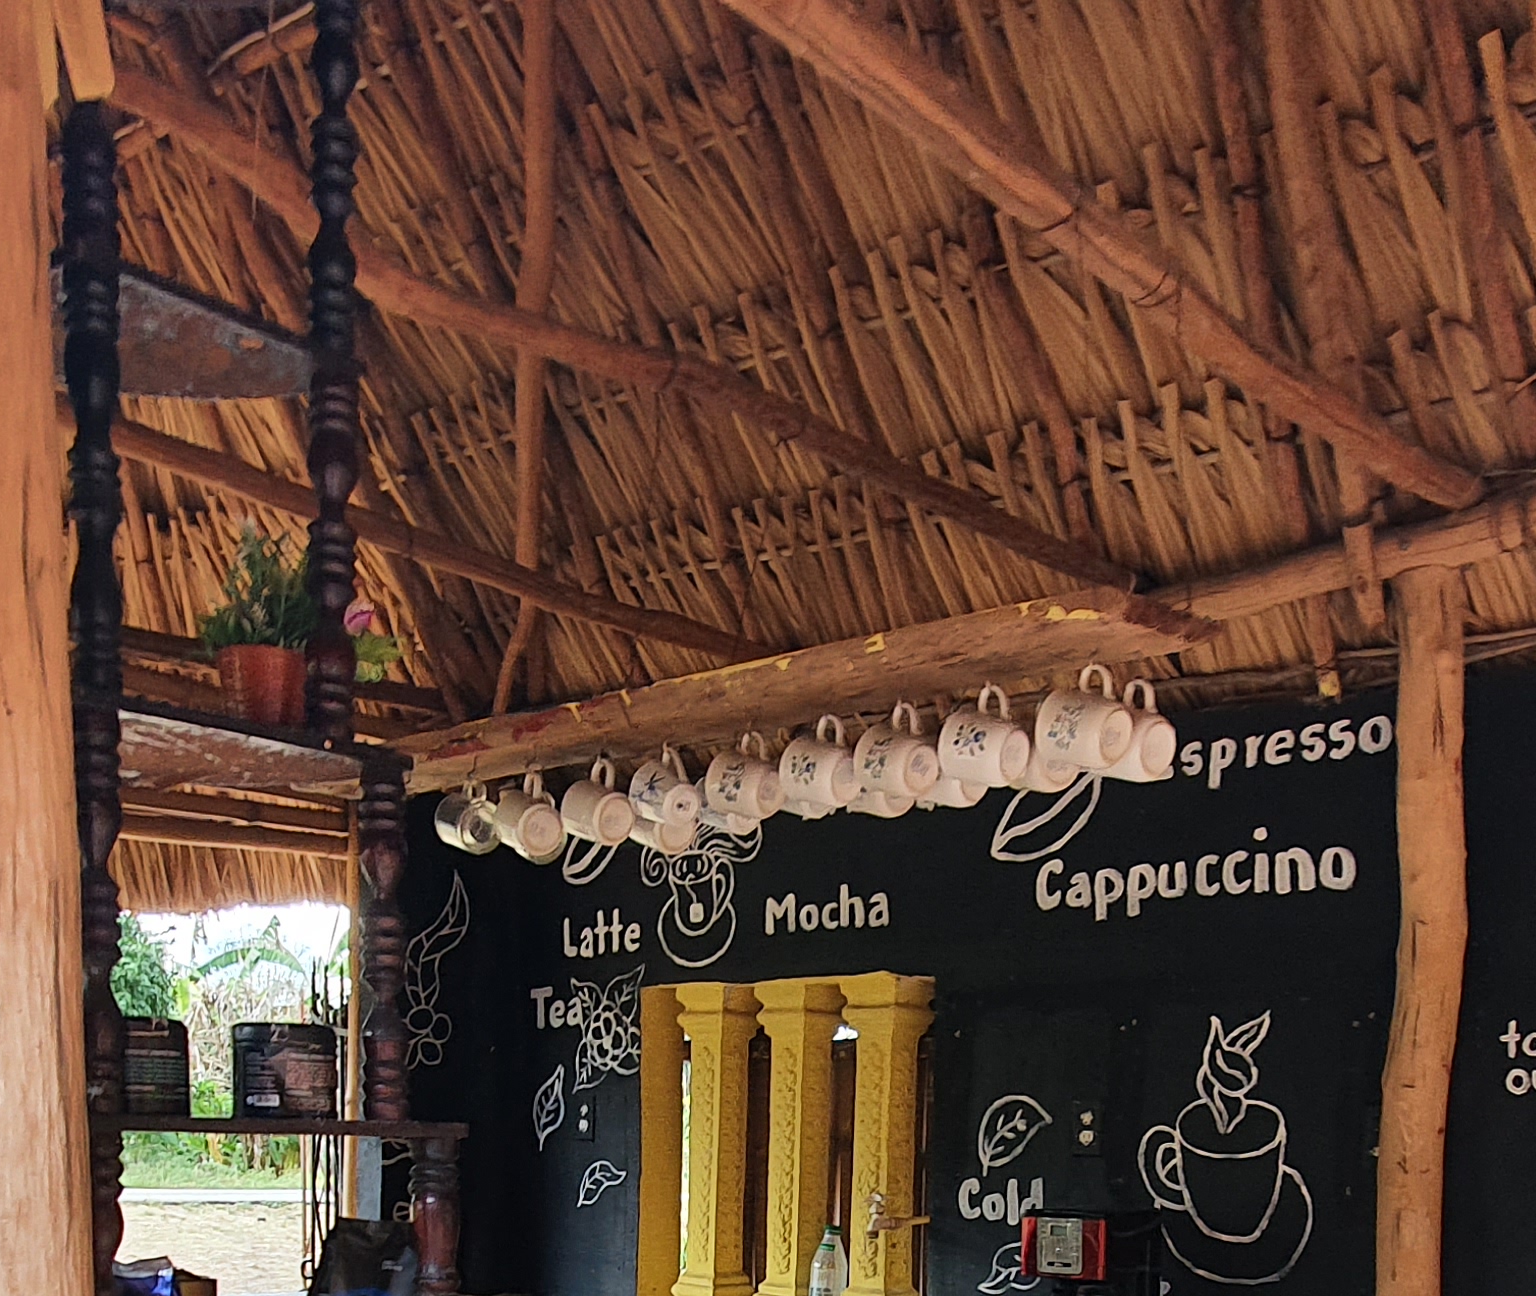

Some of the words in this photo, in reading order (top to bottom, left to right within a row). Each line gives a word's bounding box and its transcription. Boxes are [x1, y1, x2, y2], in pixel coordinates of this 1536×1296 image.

[1180, 714, 1394, 790] spresso
[1035, 826, 1357, 921] Cappuccino
[562, 909, 642, 959] Latte
[764, 884, 890, 936] Mocha
[530, 986, 583, 1030] Tea
[957, 1176, 1044, 1226] Cold
